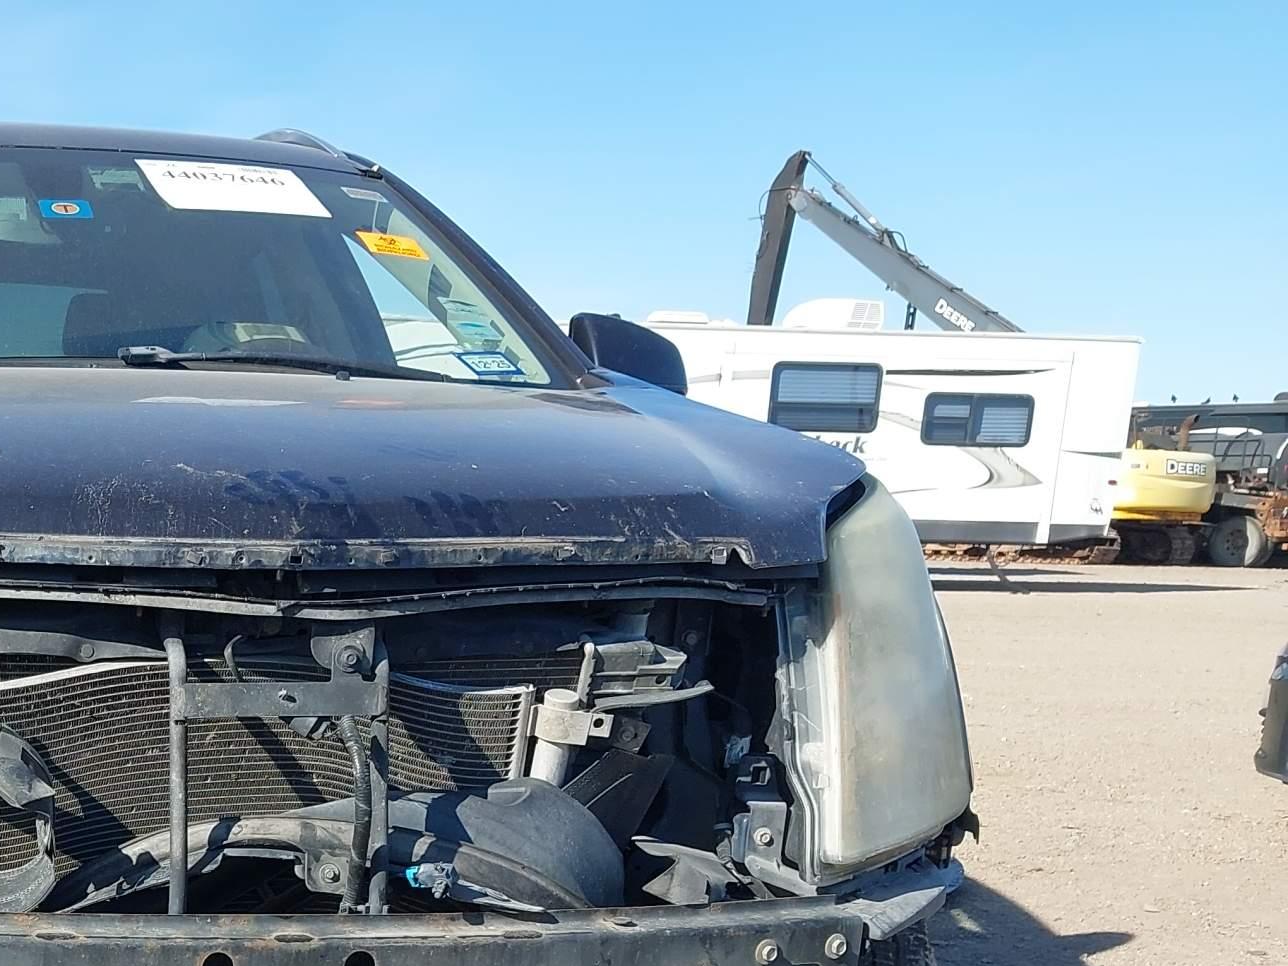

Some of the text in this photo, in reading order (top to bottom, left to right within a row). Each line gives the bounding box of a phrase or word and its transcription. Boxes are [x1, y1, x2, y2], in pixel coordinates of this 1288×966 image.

[162, 169, 285, 187] 44037646
[934, 298, 976, 332] DEERE
[1167, 458, 1207, 477] DEERE
